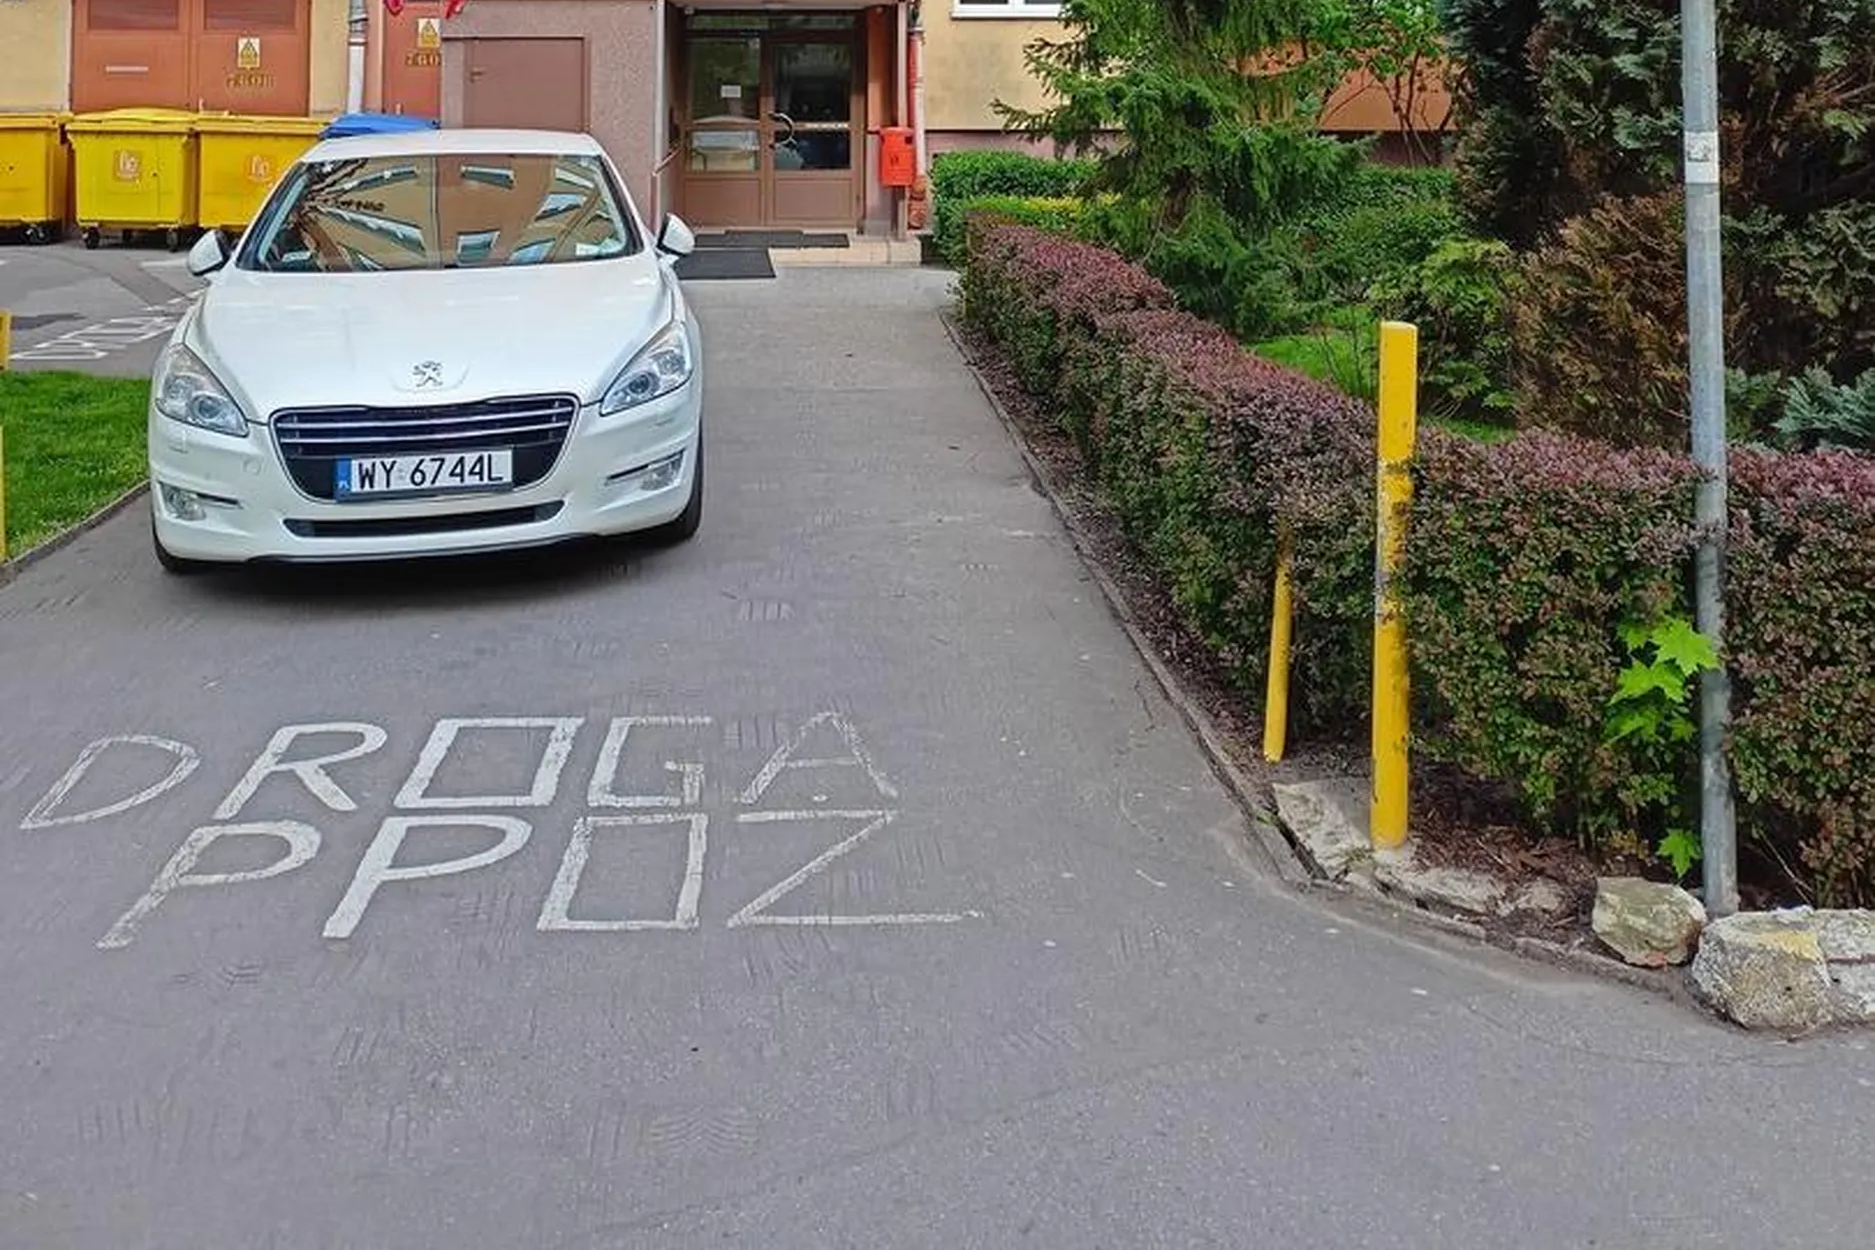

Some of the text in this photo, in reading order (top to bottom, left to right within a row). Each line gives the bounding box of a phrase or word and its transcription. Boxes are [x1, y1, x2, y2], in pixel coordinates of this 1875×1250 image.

[358, 453, 503, 490] WY 6744L
[18, 712, 899, 830] DROGA
